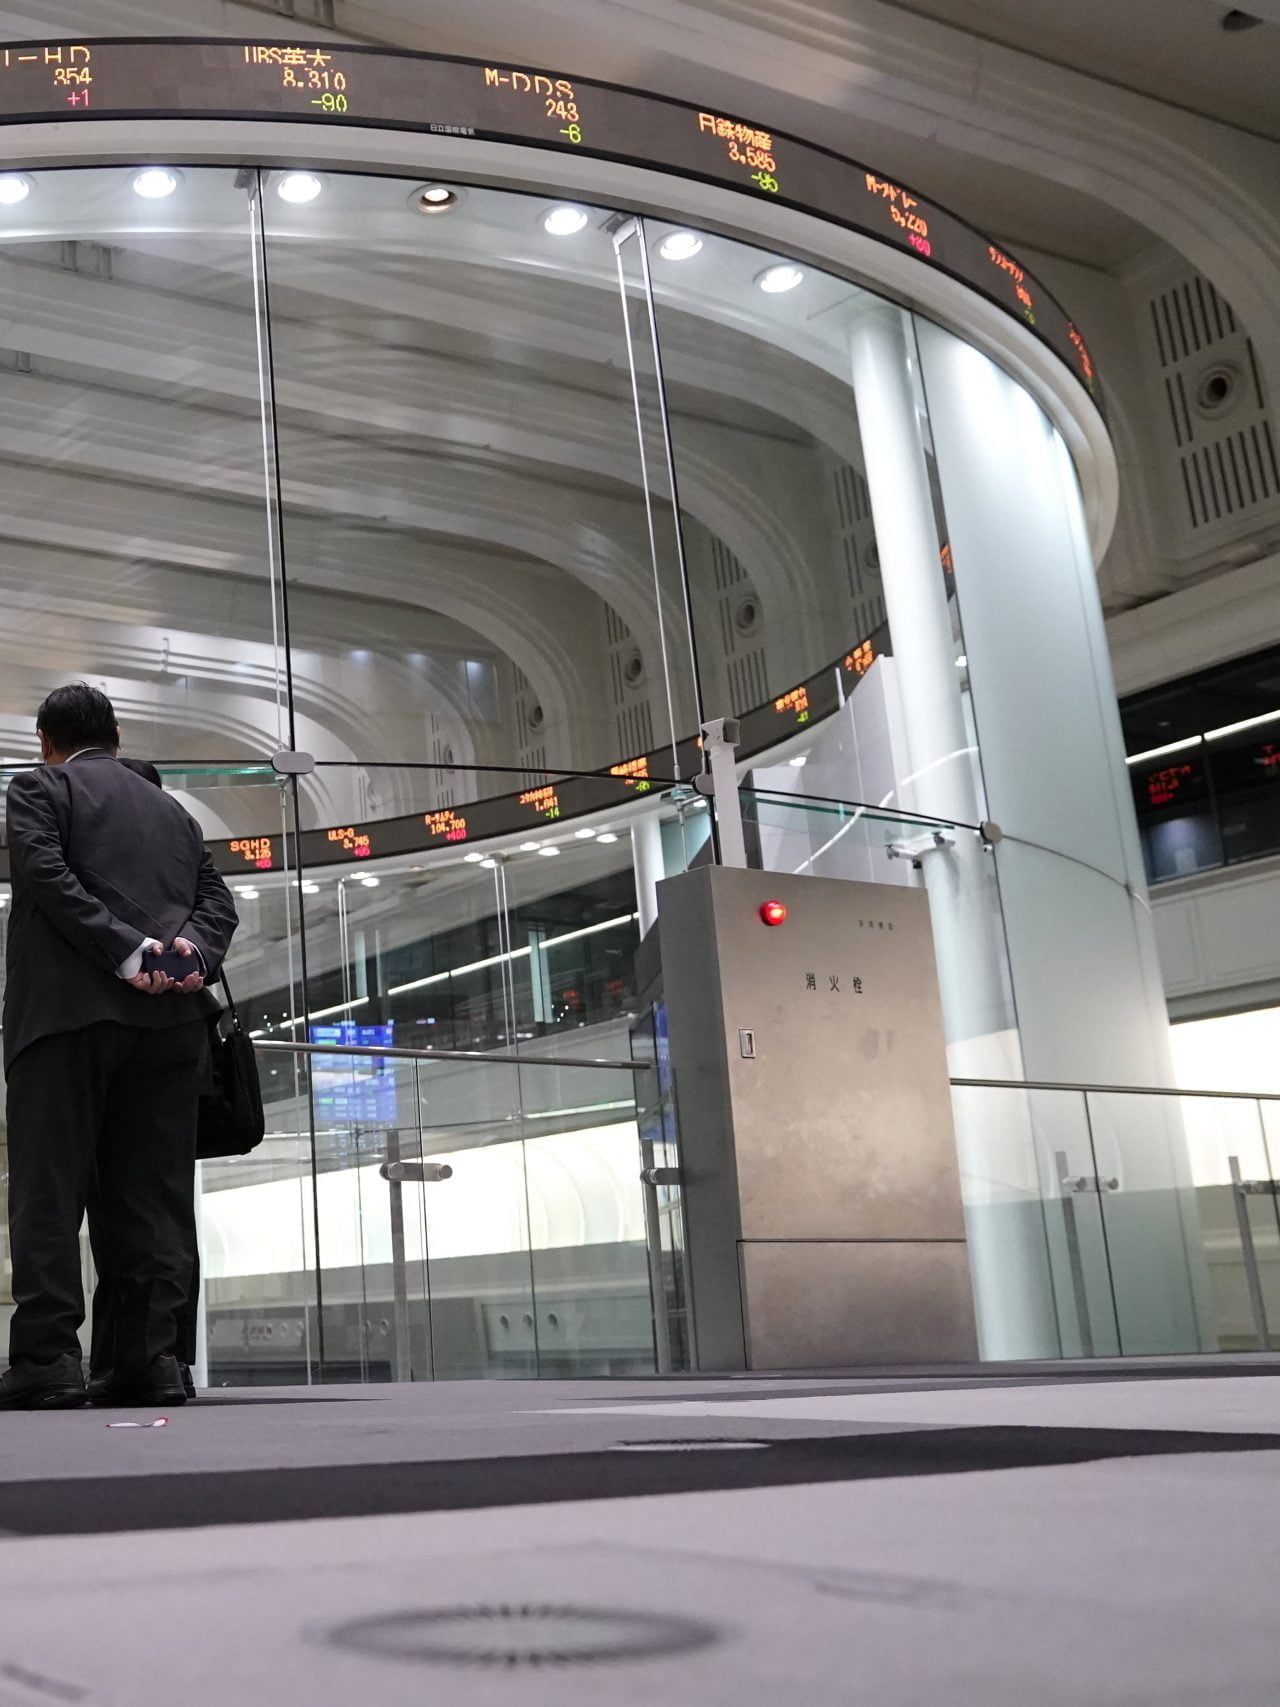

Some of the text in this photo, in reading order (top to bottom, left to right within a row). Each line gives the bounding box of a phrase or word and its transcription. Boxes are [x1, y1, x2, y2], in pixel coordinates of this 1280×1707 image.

[54, 67, 93, 86] 354
[484, 67, 574, 99] M-DDS
[67, 89, 90, 107] +1
[311, 93, 348, 112] -90
[545, 98, 580, 122] 243
[559, 124, 582, 143] -6
[230, 838, 271, 852] SGHD
[805, 972, 863, 994] 消火栓
